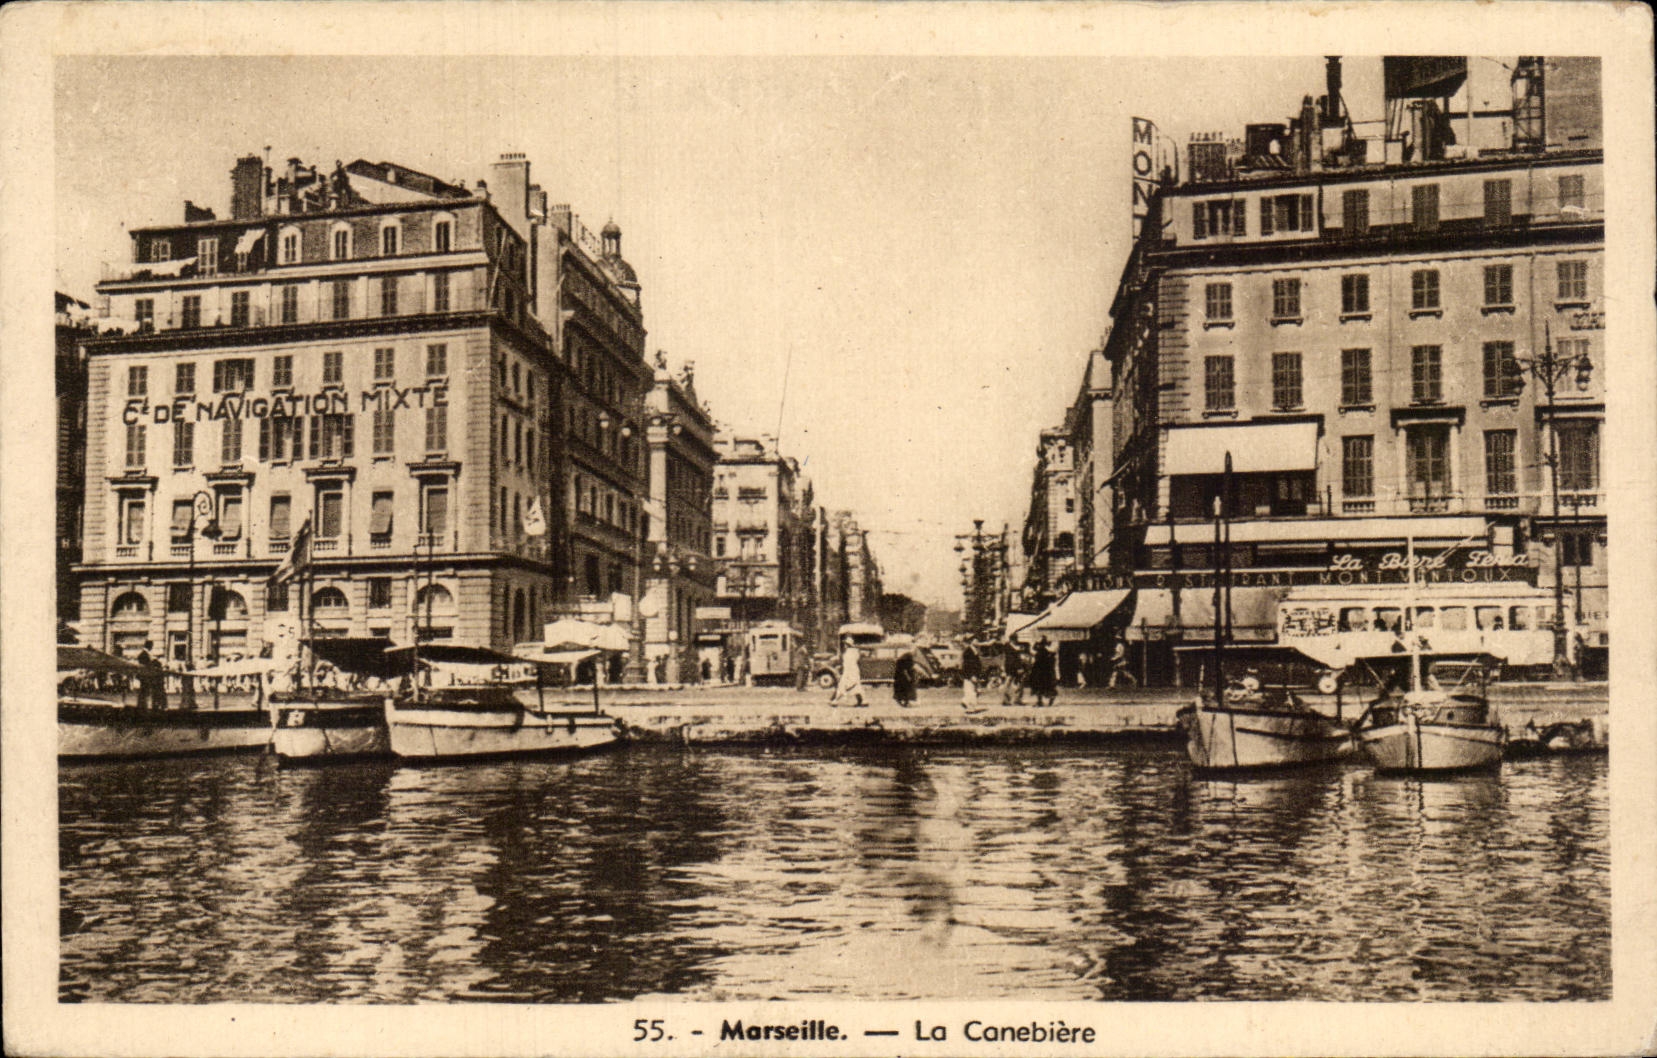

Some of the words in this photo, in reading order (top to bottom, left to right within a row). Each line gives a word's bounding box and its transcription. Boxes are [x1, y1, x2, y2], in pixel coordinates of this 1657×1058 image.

[154, 403, 186, 424] DE
[196, 391, 349, 422] NAVIGATION
[361, 385, 449, 412] MIXTE
[1329, 553, 1364, 571] La
[1319, 570, 1382, 585] MONT
[1399, 567, 1511, 583] VNTOUX
